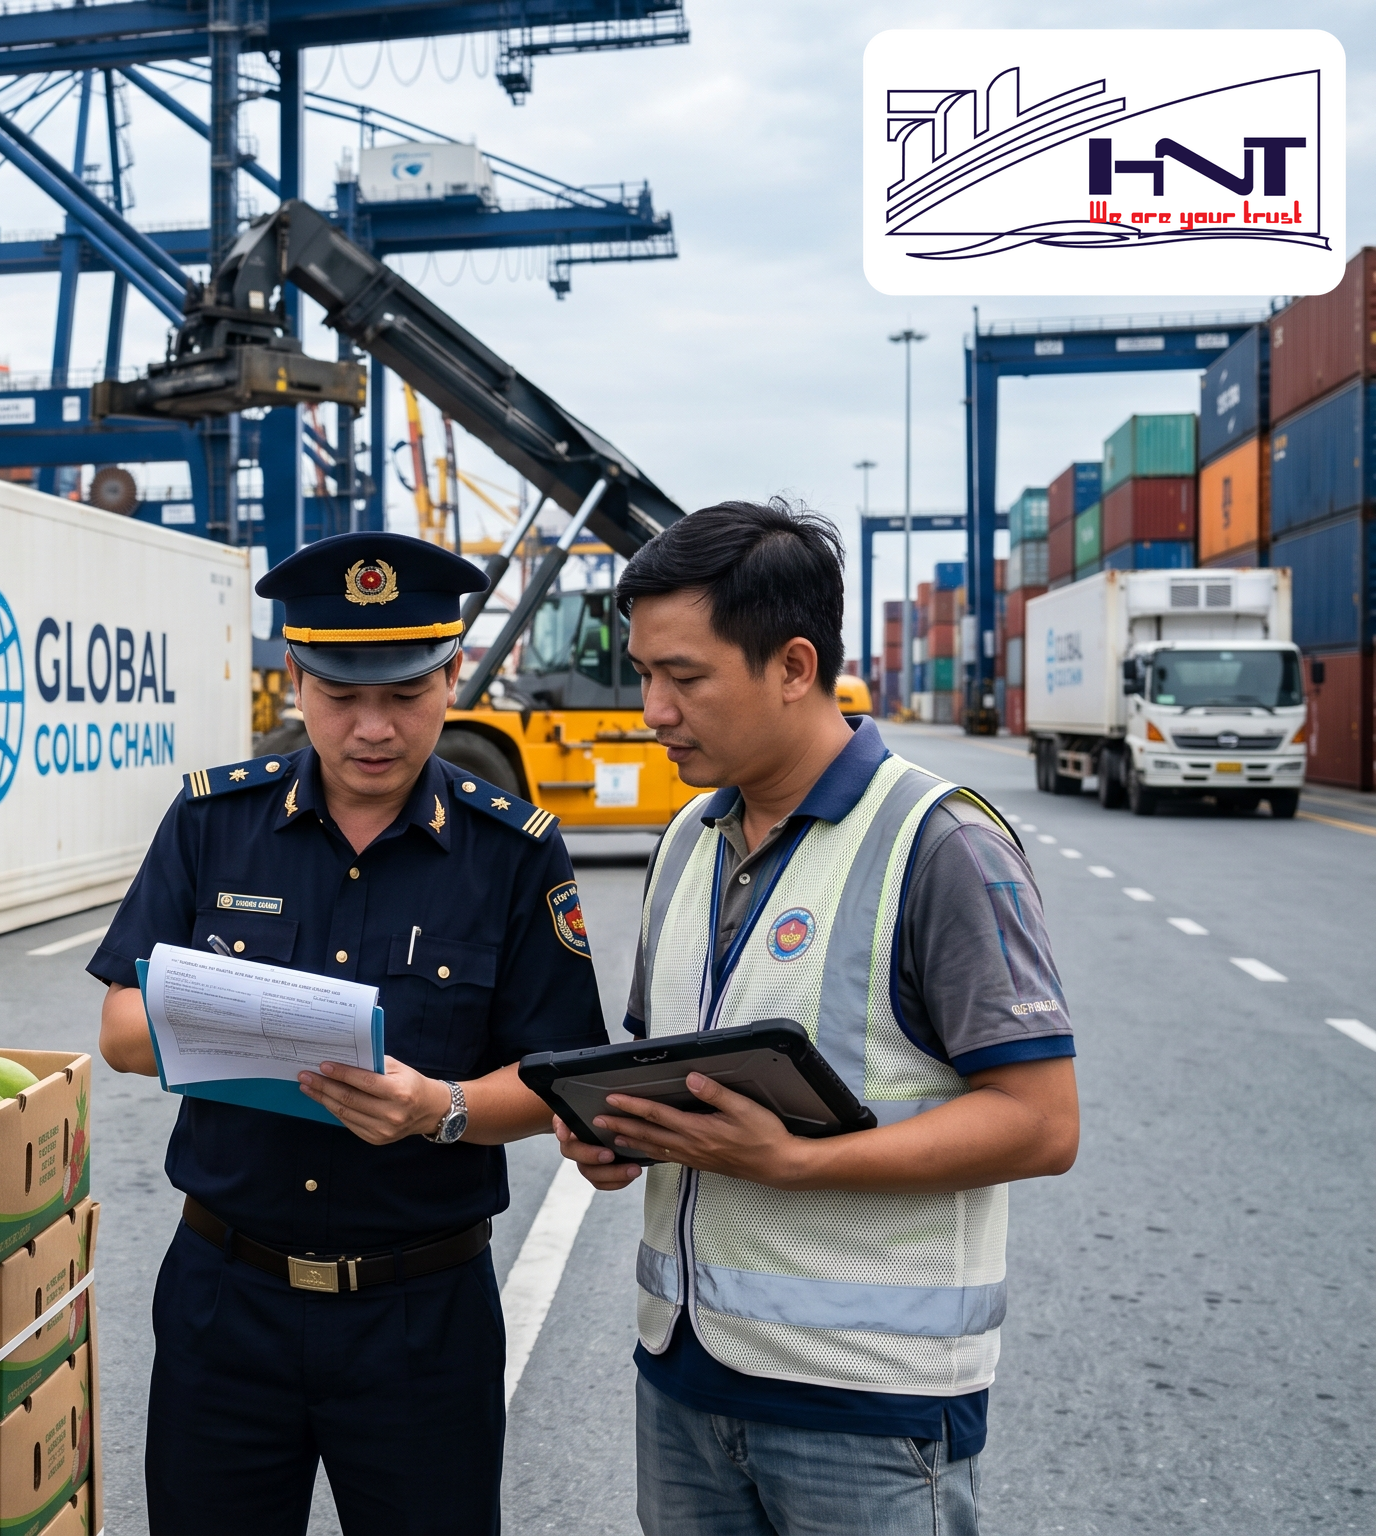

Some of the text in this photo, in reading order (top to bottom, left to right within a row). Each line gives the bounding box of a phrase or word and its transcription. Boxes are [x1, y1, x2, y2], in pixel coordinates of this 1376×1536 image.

[34, 616, 176, 704] GLOBAL
[34, 721, 175, 776] COLD CHAIN
